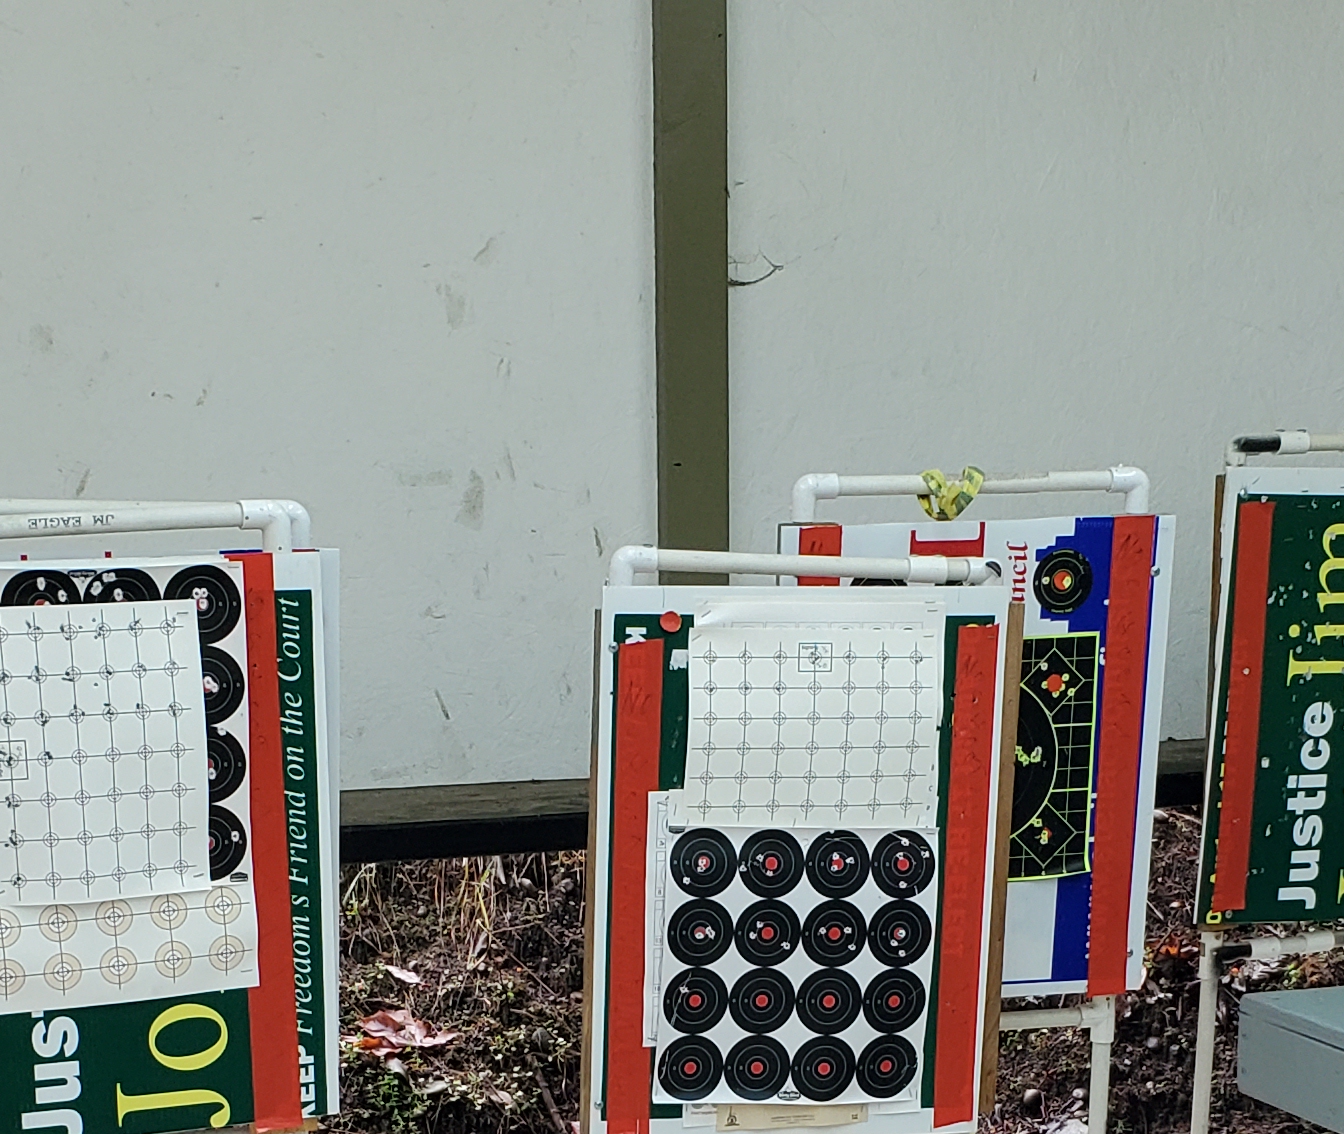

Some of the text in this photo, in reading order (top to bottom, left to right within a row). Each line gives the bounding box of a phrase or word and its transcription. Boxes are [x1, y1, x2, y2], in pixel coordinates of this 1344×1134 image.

[27, 516, 82, 530] EAGLE
[92, 513, 115, 527] JM
[276, 597, 302, 682] Court
[280, 691, 304, 736] the
[286, 745, 305, 781] on
[1277, 701, 1334, 910] Justice
[284, 790, 309, 886] Friend
